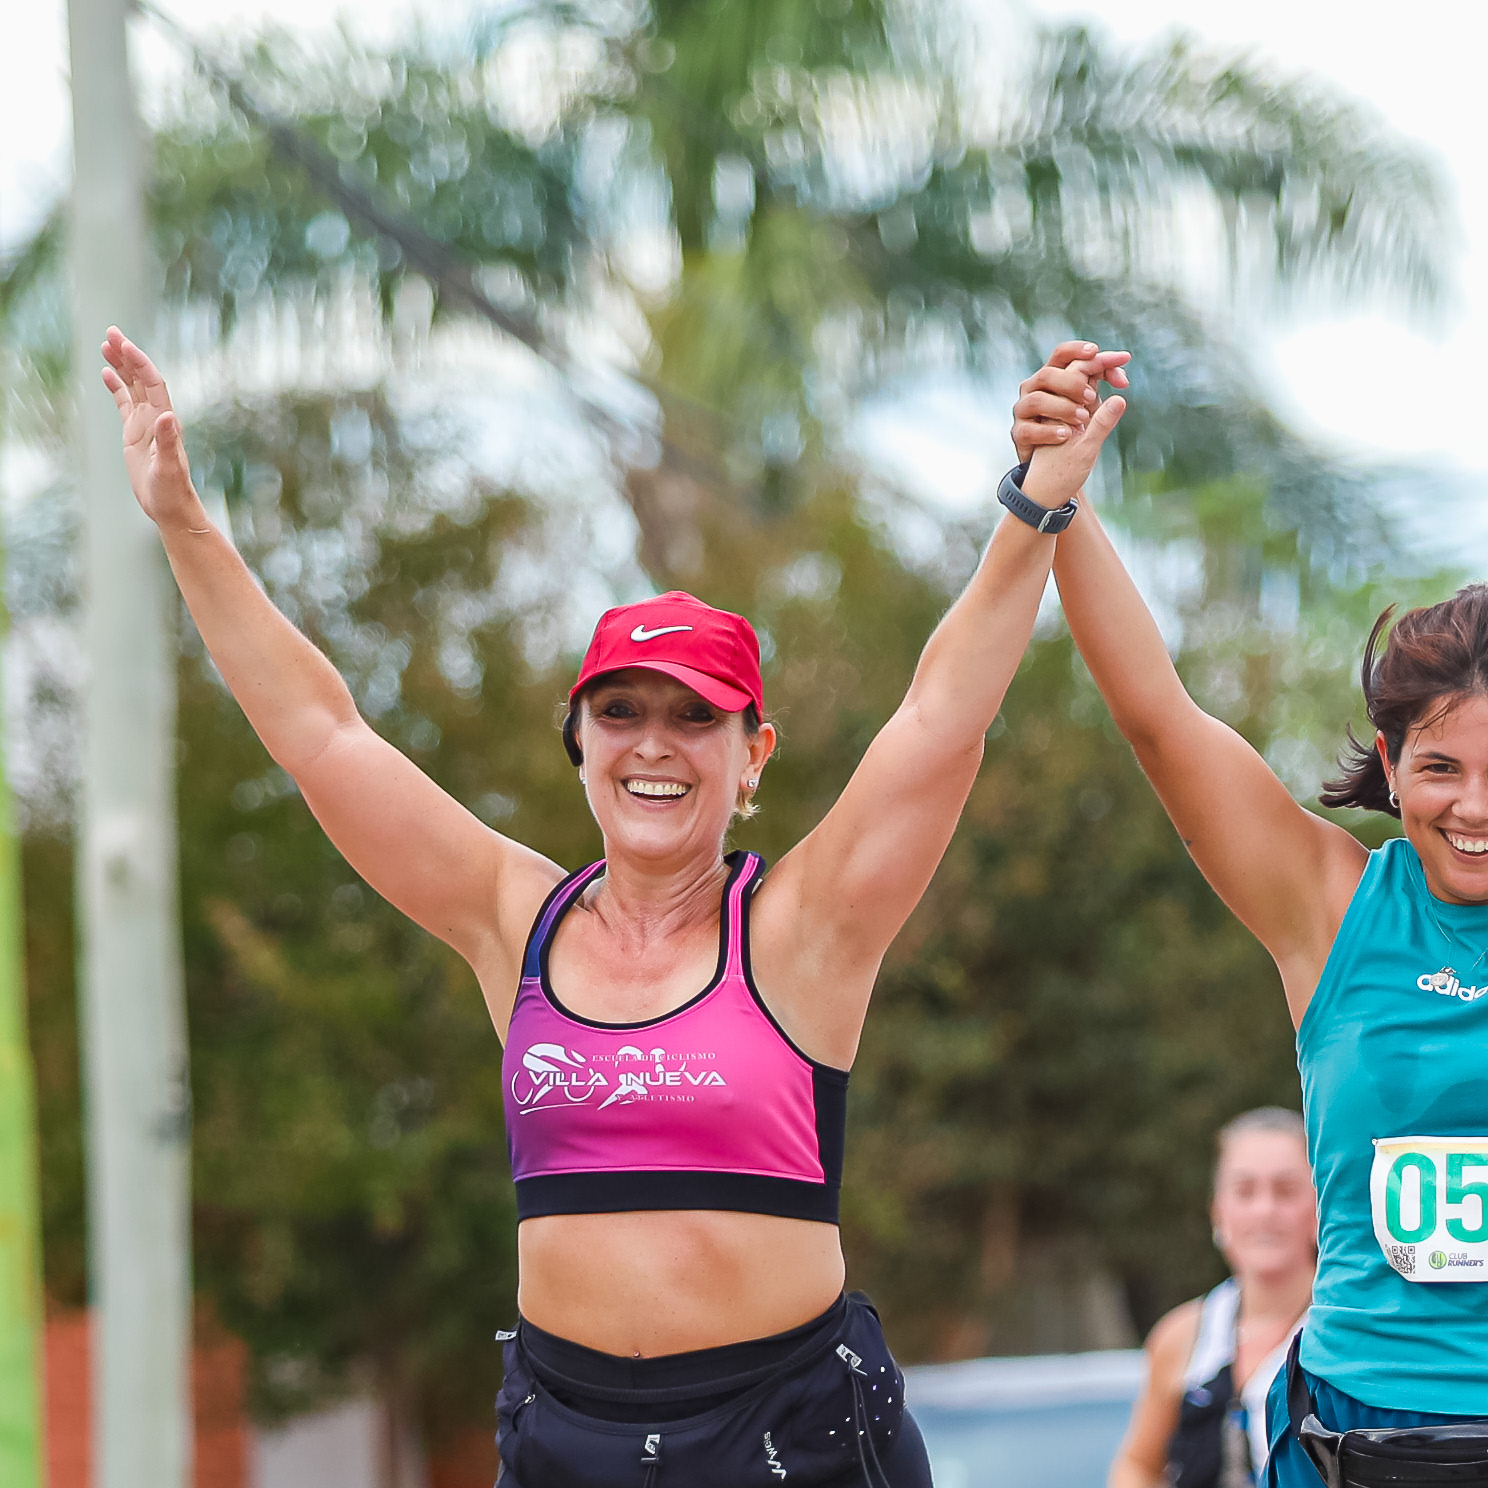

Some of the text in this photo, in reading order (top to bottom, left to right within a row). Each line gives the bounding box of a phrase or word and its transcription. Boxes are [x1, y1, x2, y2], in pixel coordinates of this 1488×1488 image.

[528, 1071, 727, 1086] VILLA NUEVA
[1448, 1252, 1468, 1260] CLUB
[1447, 1259, 1485, 1267] RUNNER'S
